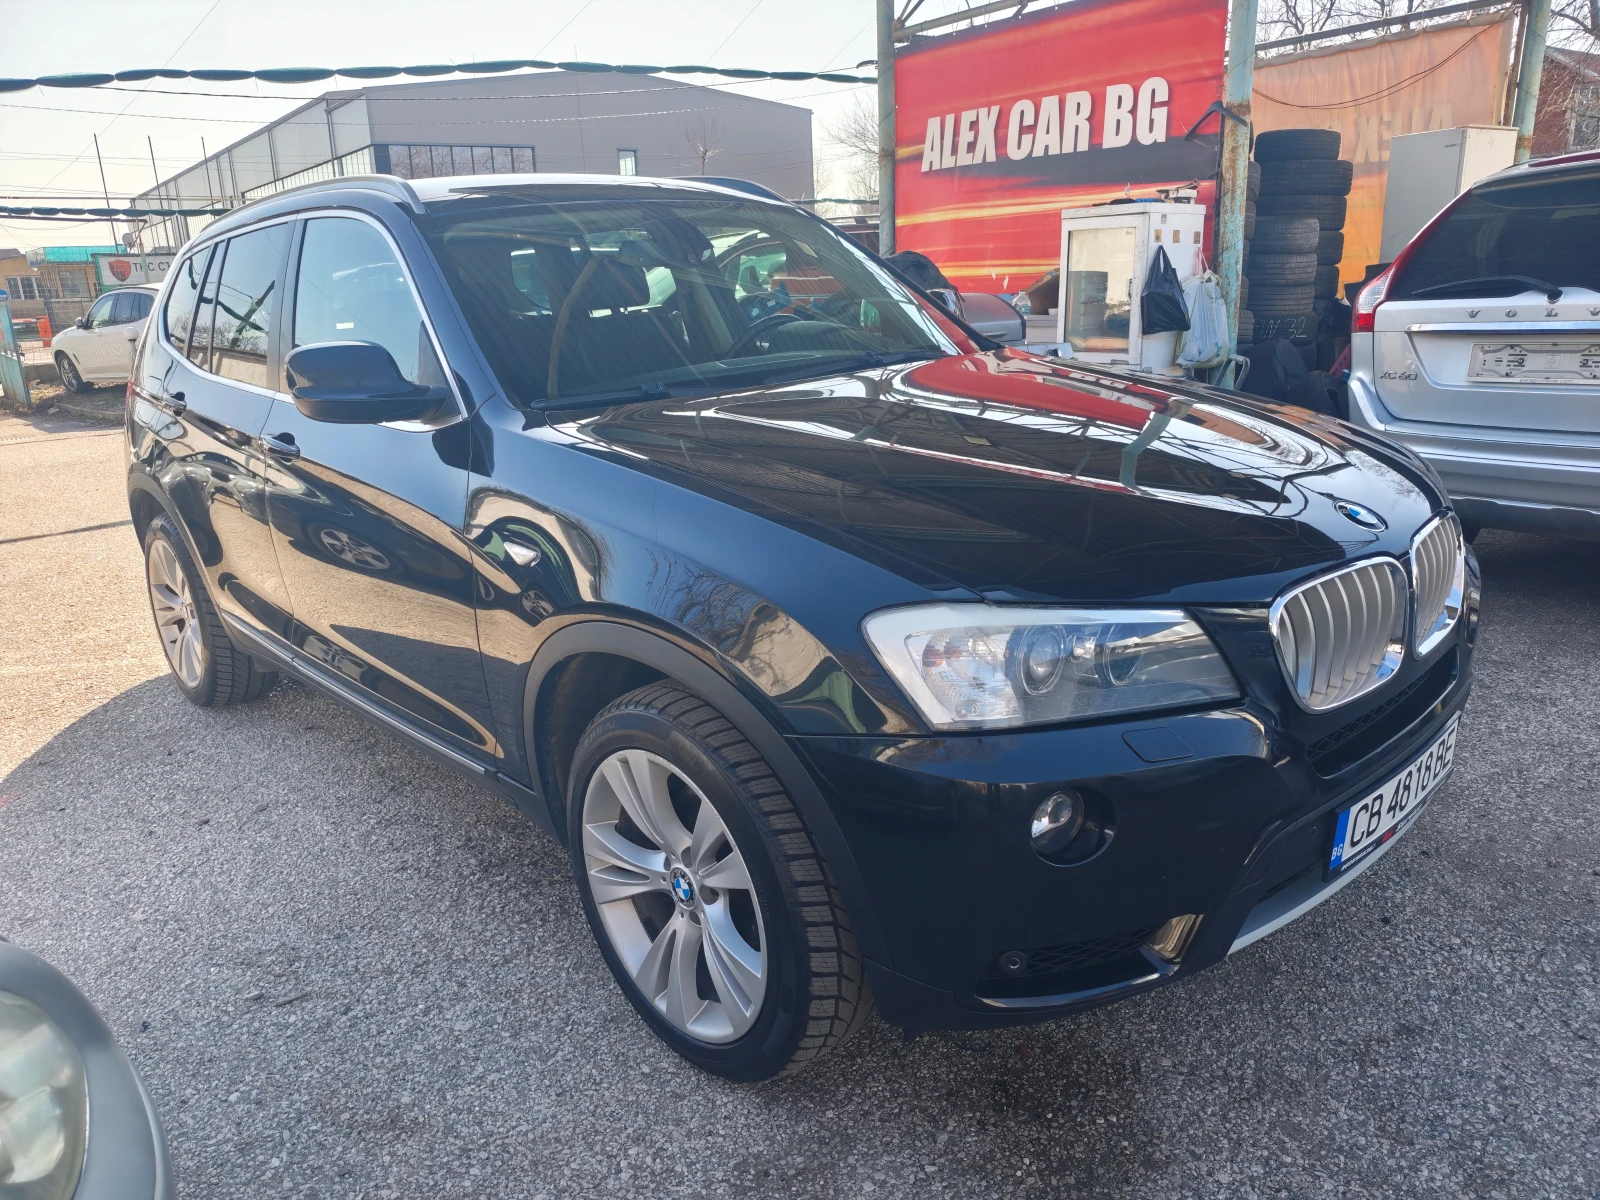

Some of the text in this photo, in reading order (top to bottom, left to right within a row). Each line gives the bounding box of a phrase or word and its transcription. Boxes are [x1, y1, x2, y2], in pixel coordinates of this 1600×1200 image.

[921, 76, 1169, 172] ALEX CAR BG
[1350, 793, 1383, 848] CB
[1387, 750, 1434, 819] 4818
[1433, 726, 1456, 781] BE
[1331, 843, 1344, 861] BG
